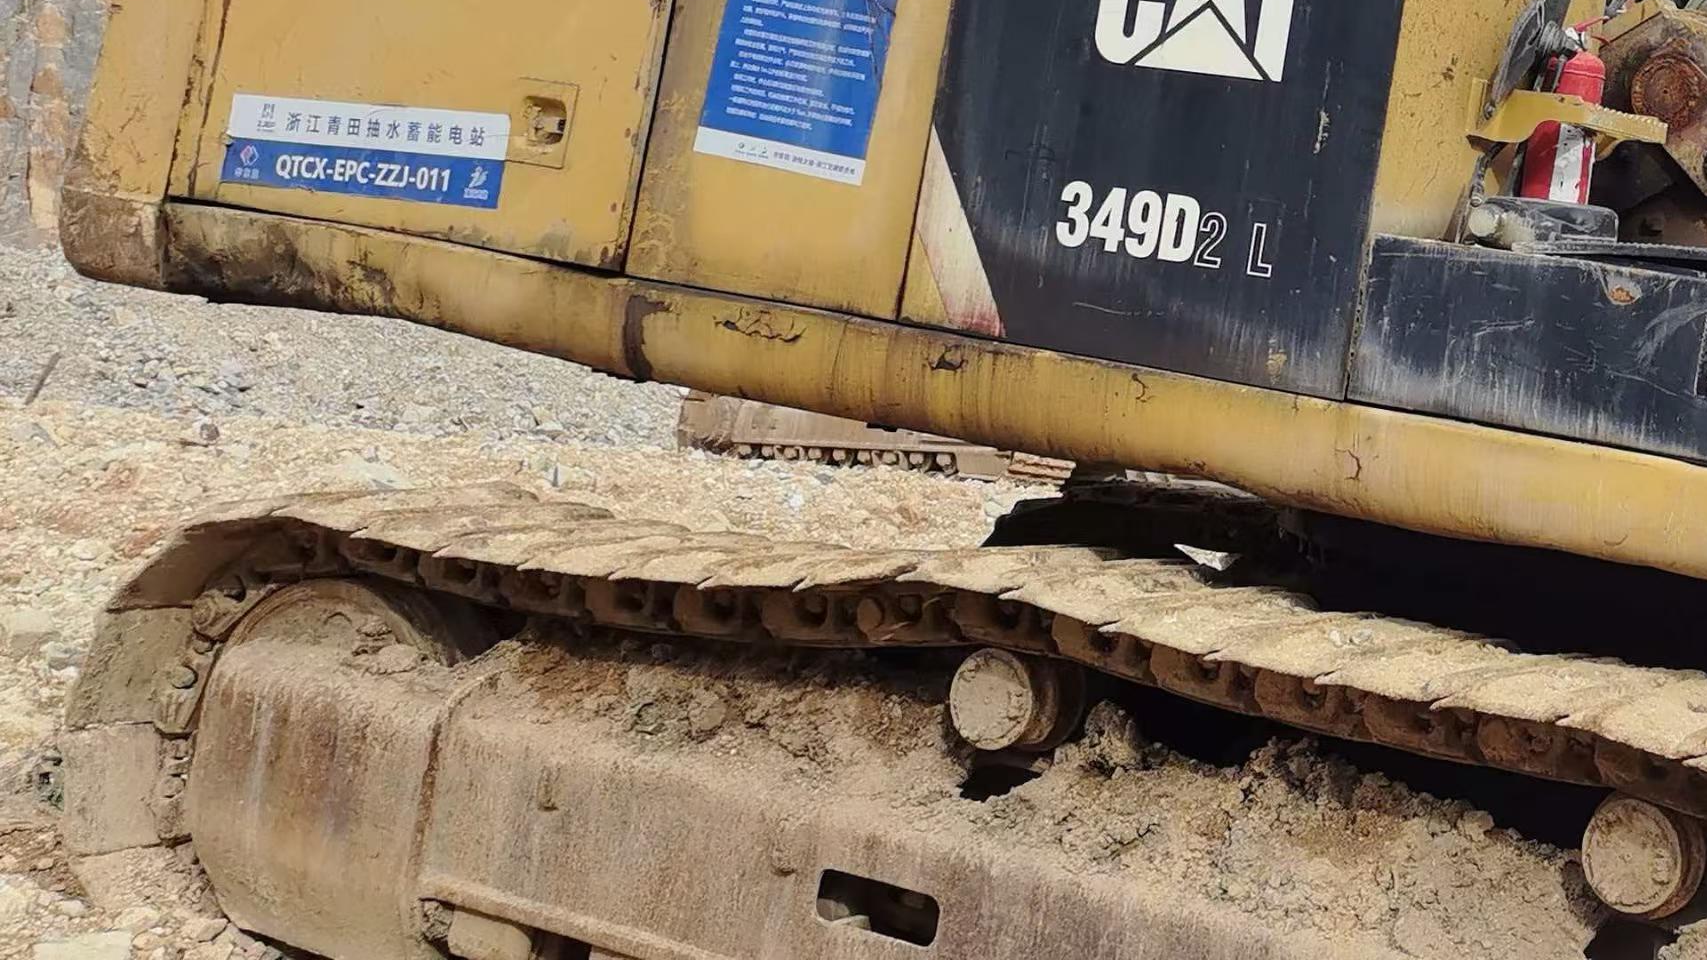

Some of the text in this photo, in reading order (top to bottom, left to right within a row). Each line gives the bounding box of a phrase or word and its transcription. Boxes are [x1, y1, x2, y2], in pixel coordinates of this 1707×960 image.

[285, 111, 486, 147] 浙江青田抽水蓄能电站
[275, 154, 451, 193] QTCX-EPC-ZZJ-011
[1055, 180, 1274, 278] 349D2 L
